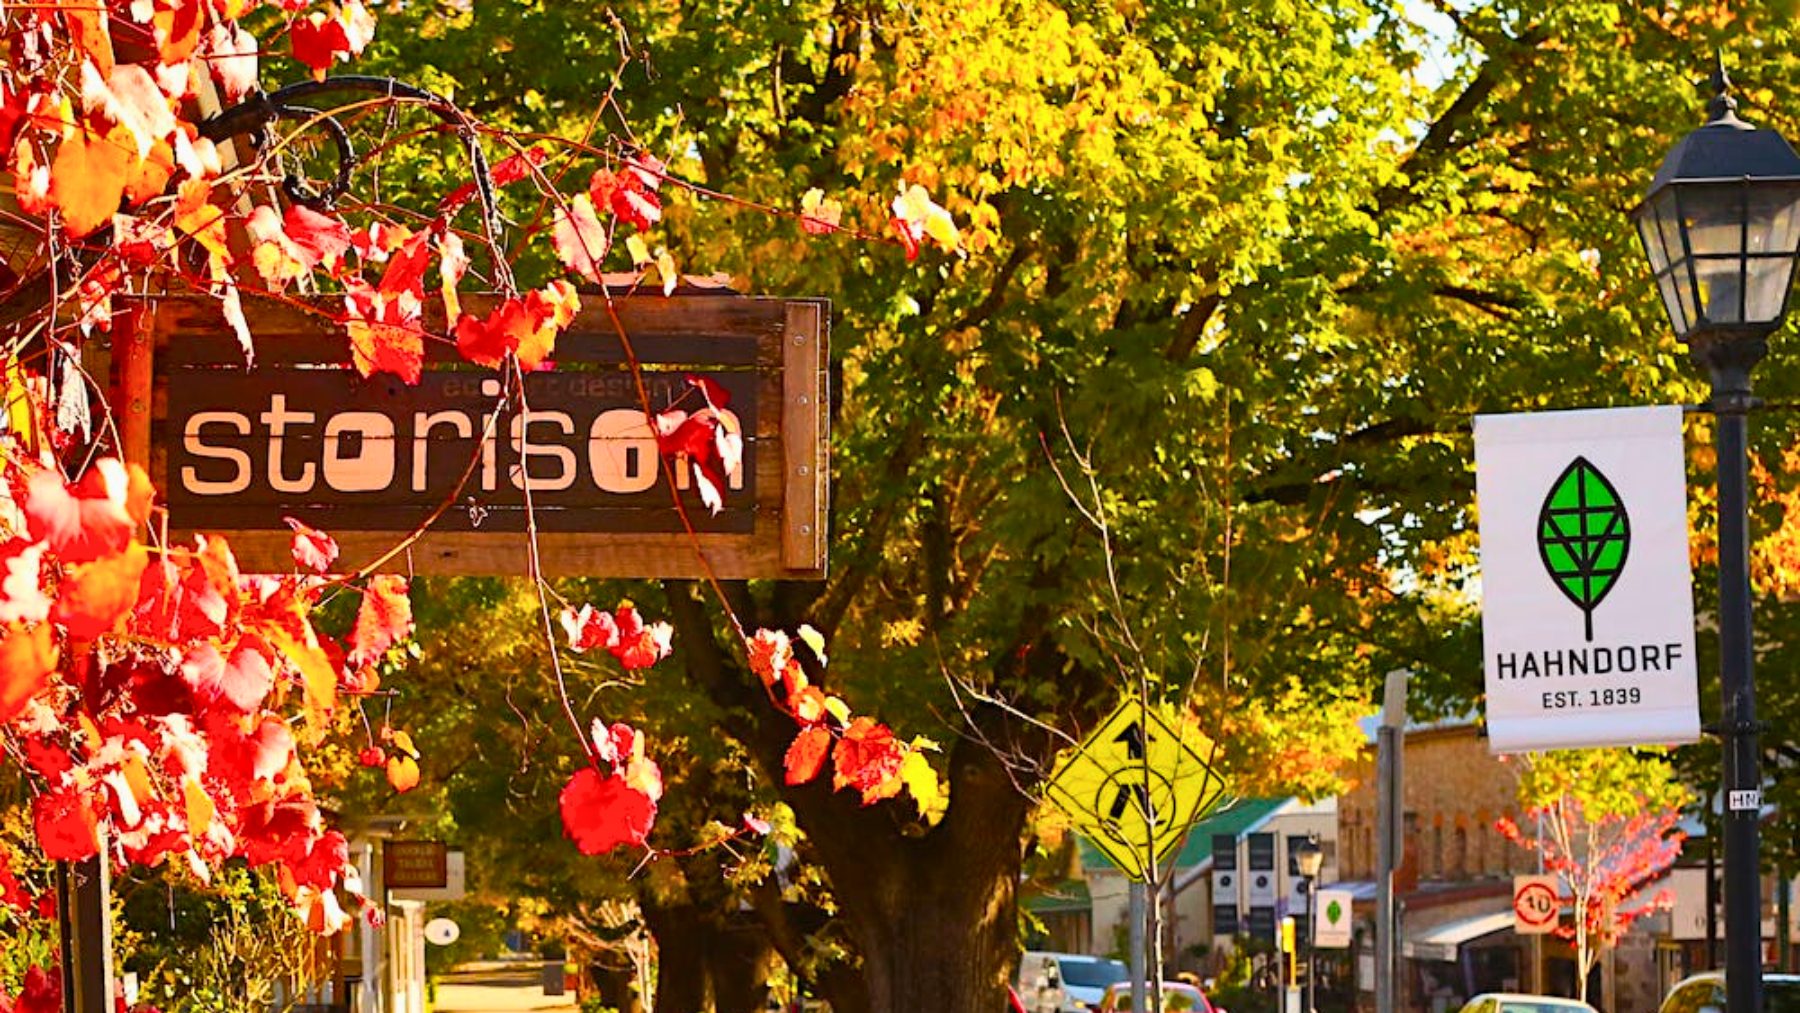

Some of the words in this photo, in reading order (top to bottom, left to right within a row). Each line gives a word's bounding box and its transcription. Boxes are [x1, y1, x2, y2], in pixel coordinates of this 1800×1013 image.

[1497, 644, 1682, 680] HAHNDORF
[1542, 690, 1583, 709] EST.
[1590, 688, 1641, 706] 1839
